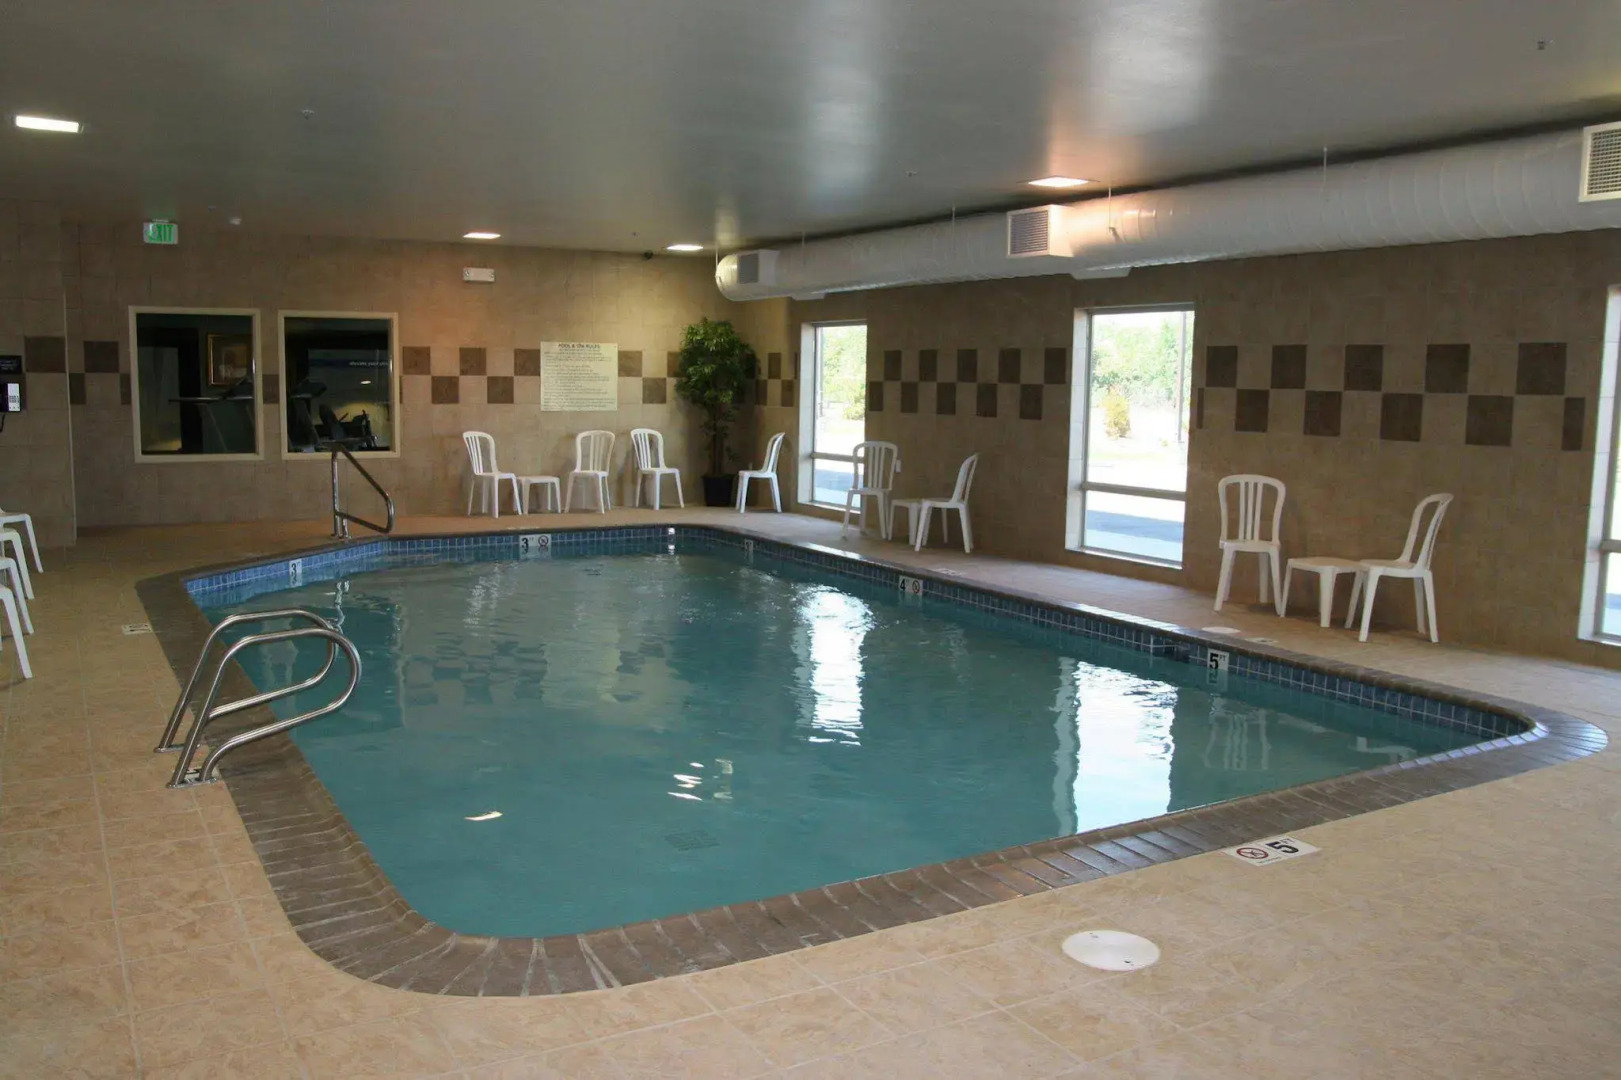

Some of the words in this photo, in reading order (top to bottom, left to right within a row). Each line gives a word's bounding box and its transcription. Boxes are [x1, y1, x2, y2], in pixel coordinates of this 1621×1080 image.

[147, 223, 174, 242] EXIT
[521, 537, 529, 548] 3
[291, 562, 297, 575] 3
[900, 578, 906, 592] 4
[1210, 652, 1219, 669] 5
[1265, 841, 1299, 853] 5
